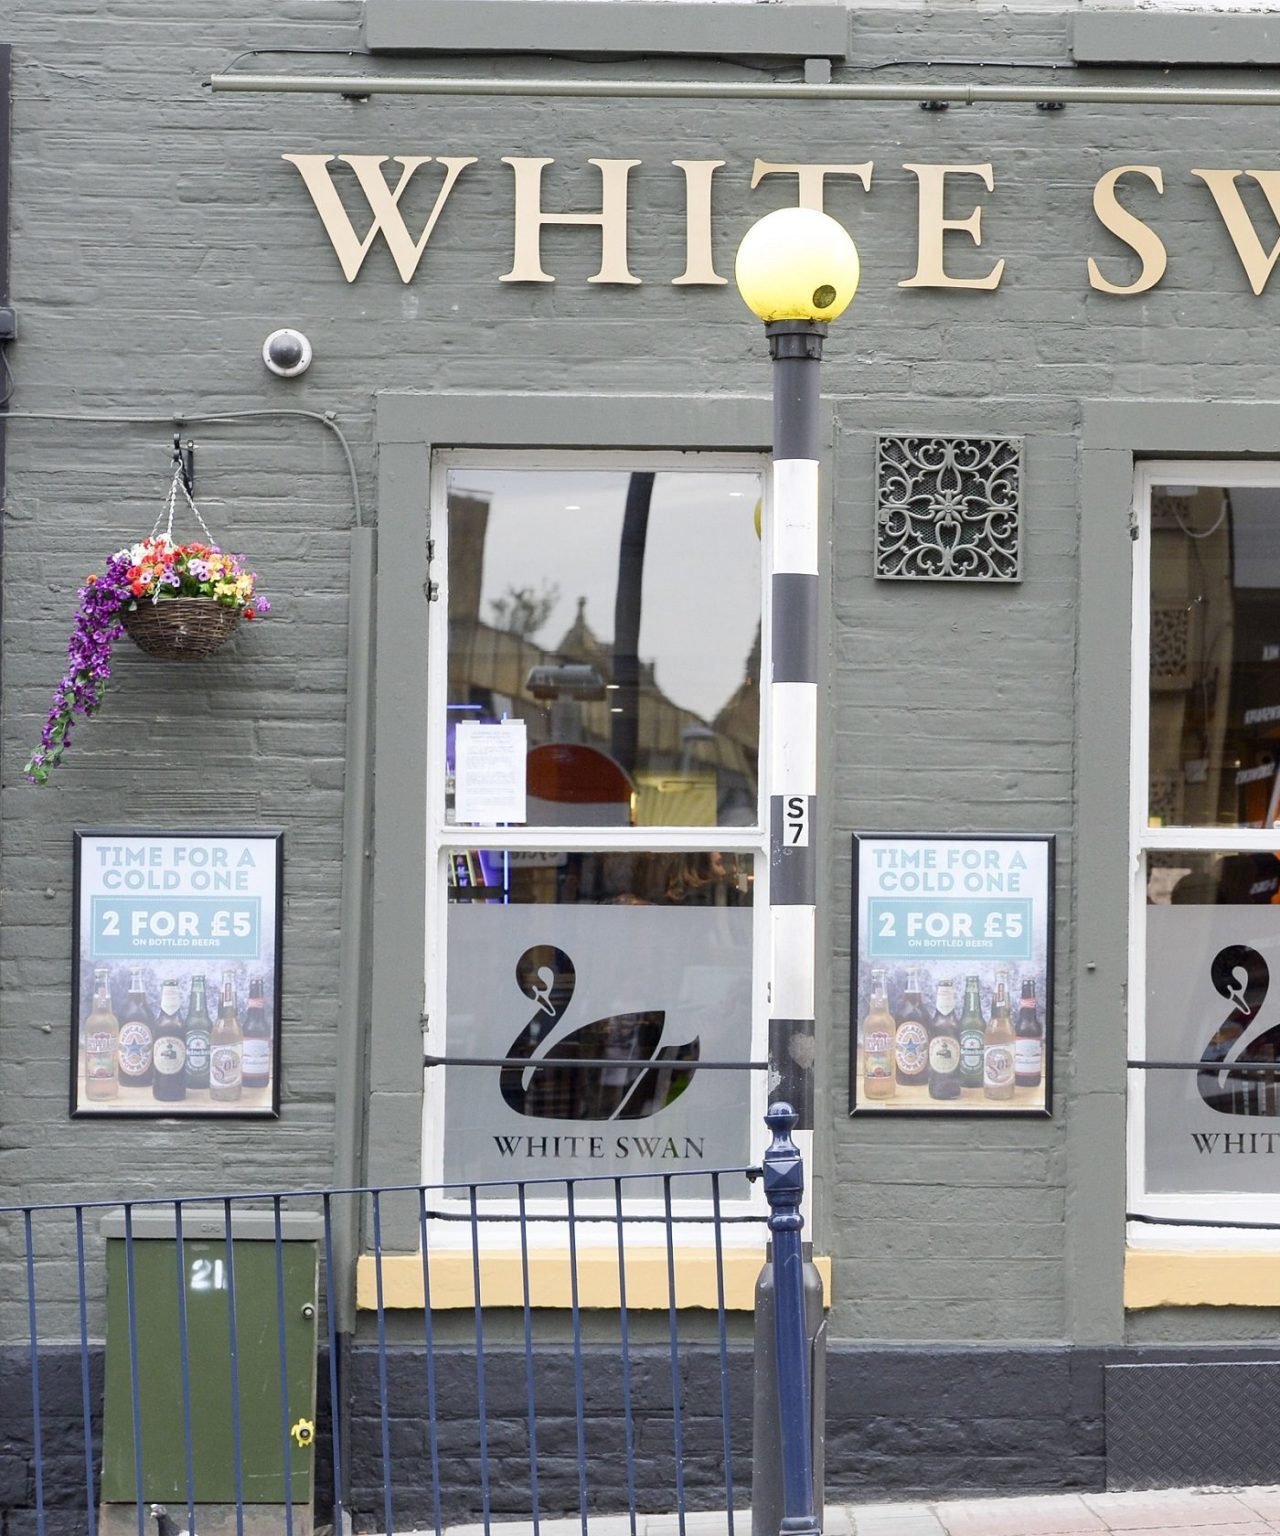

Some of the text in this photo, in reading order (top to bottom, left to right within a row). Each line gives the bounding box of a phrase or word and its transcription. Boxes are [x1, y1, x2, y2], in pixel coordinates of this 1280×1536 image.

[787, 797, 804, 818] S
[789, 823, 803, 843] 7
[96, 846, 256, 868] TIME FOR A
[872, 848, 1028, 870] TIME FOR A
[102, 869, 249, 891] COLD ONE
[878, 871, 1020, 892] COLD ONE
[102, 910, 251, 937] 2 FOR £5
[878, 912, 1023, 938] 2 FOR £5
[191, 939, 221, 947] BEERS
[908, 939, 993, 948] ON BOTTLED BEERS
[493, 1136, 705, 1159] WHITE SWAN
